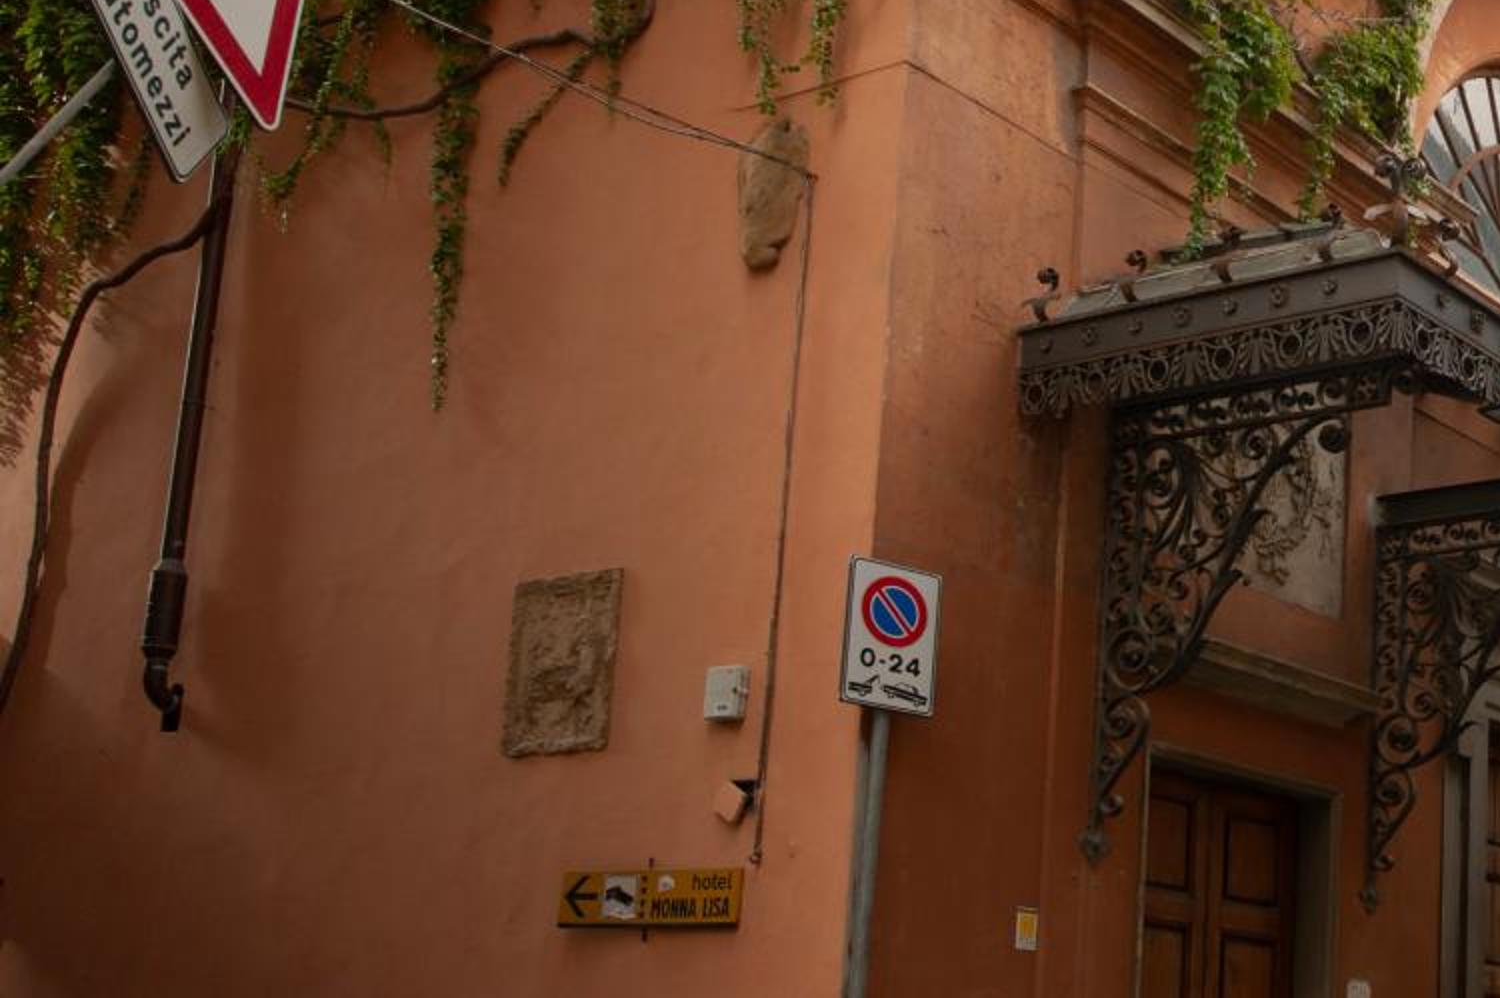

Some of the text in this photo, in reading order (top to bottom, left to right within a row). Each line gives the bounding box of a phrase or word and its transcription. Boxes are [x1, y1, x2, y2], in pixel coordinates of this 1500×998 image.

[859, 647, 921, 677] 0-24
[692, 873, 732, 891] hotel
[651, 896, 729, 920] MONNA LISA
